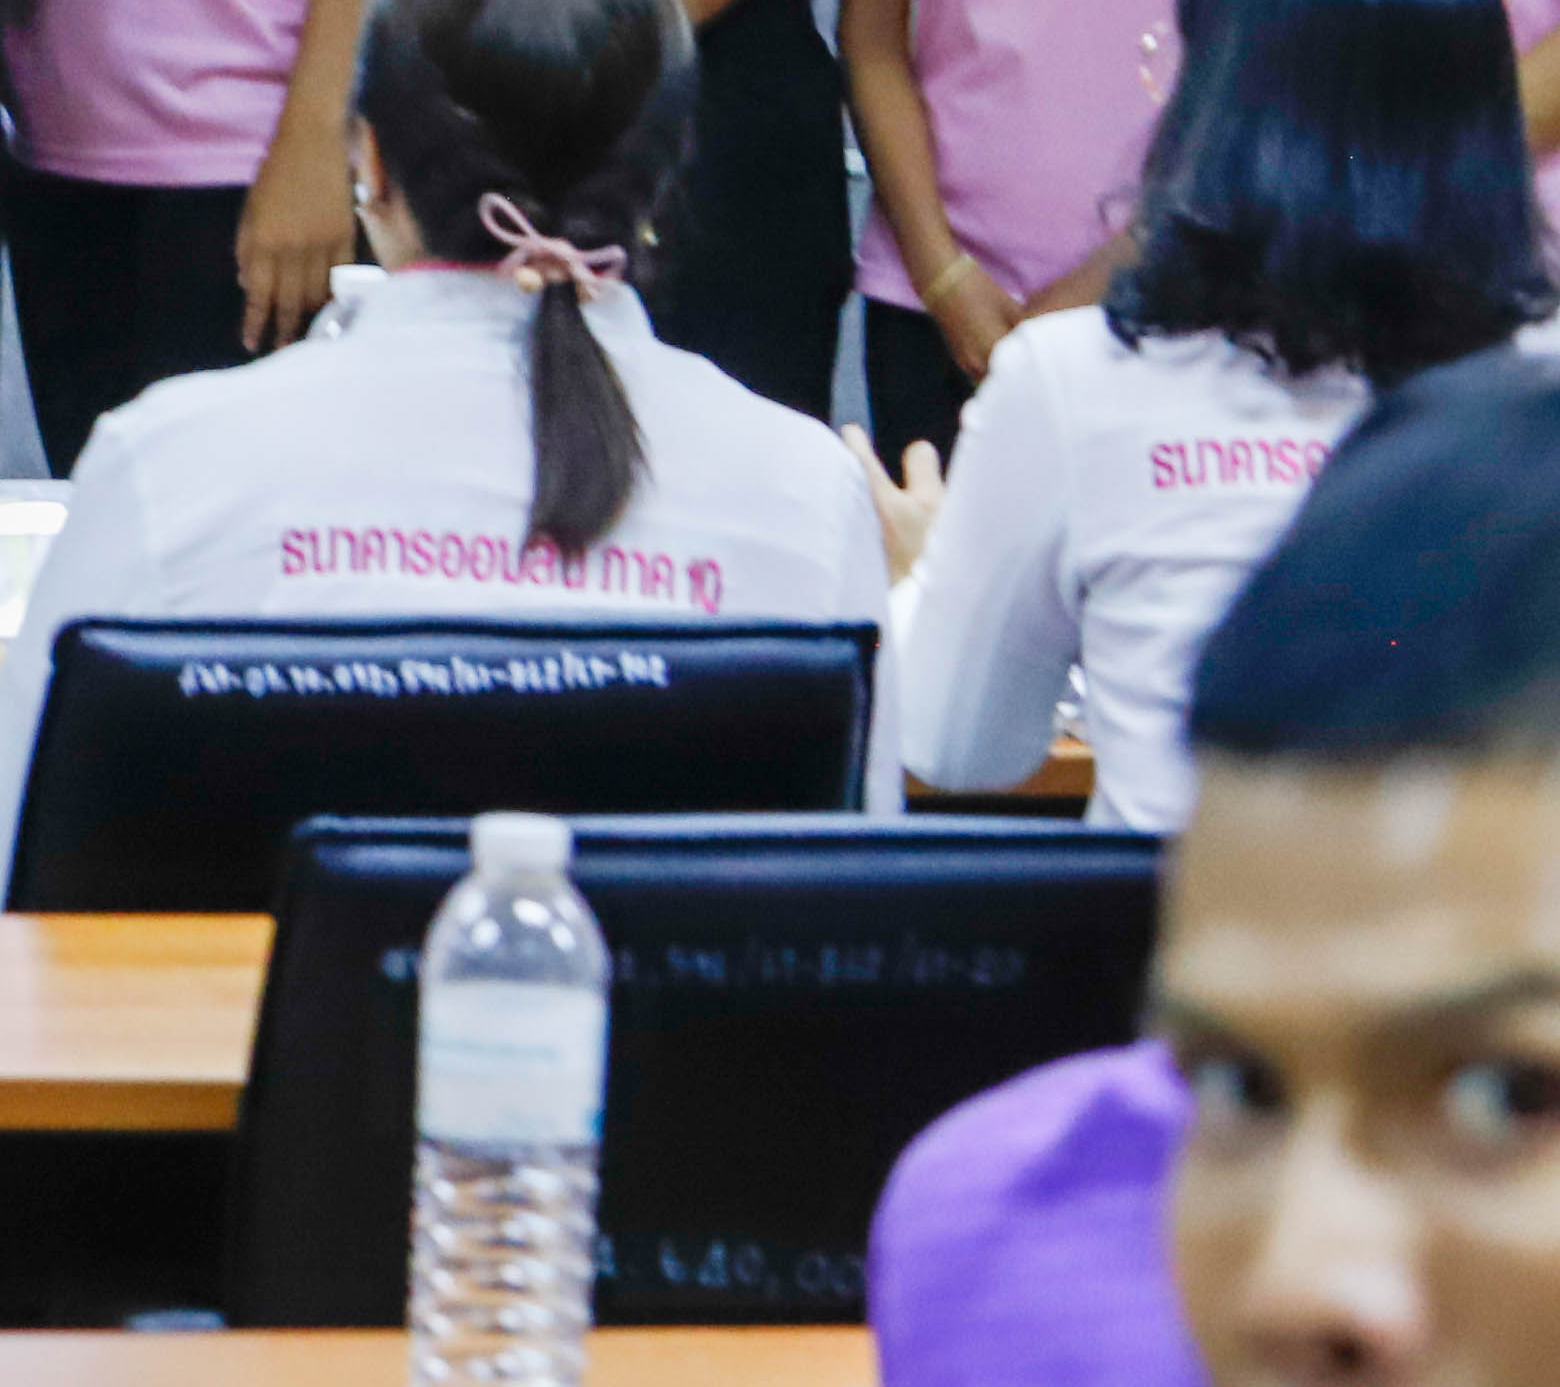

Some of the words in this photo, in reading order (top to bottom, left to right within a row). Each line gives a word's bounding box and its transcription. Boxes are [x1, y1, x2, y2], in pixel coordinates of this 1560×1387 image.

[281, 526, 587, 590] ธนาคารออมสน
